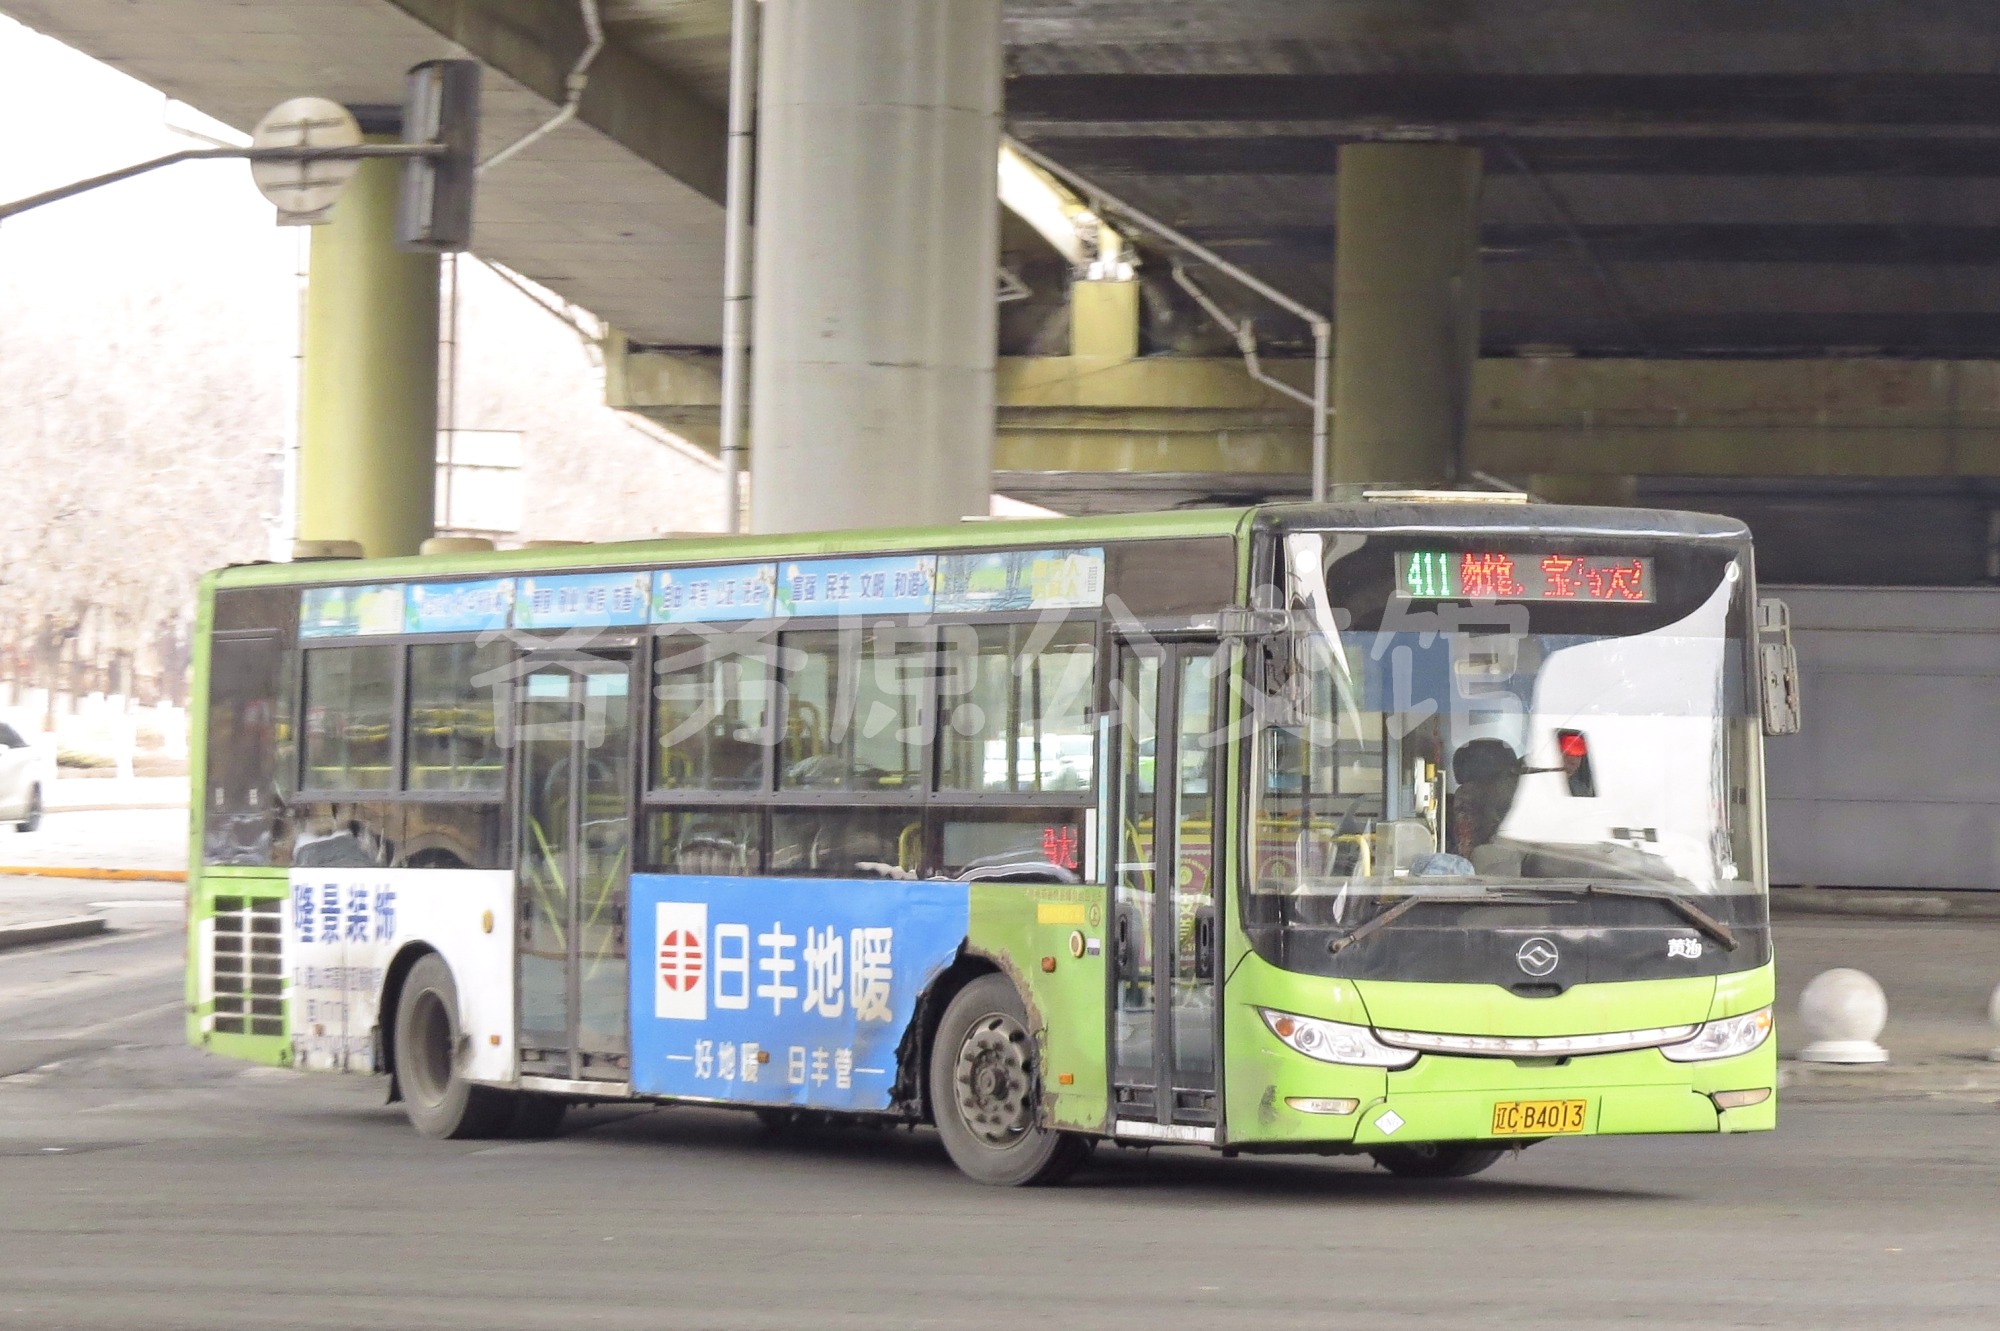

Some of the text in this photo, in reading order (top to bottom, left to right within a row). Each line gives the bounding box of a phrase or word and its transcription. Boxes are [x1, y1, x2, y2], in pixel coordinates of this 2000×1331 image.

[826, 573, 850, 600] 民主
[860, 572, 885, 599] 文明
[1407, 552, 1450, 596] 411
[714, 921, 893, 1023] 日丰地暖
[694, 1039, 853, 1090] 好地暖 日丰管
